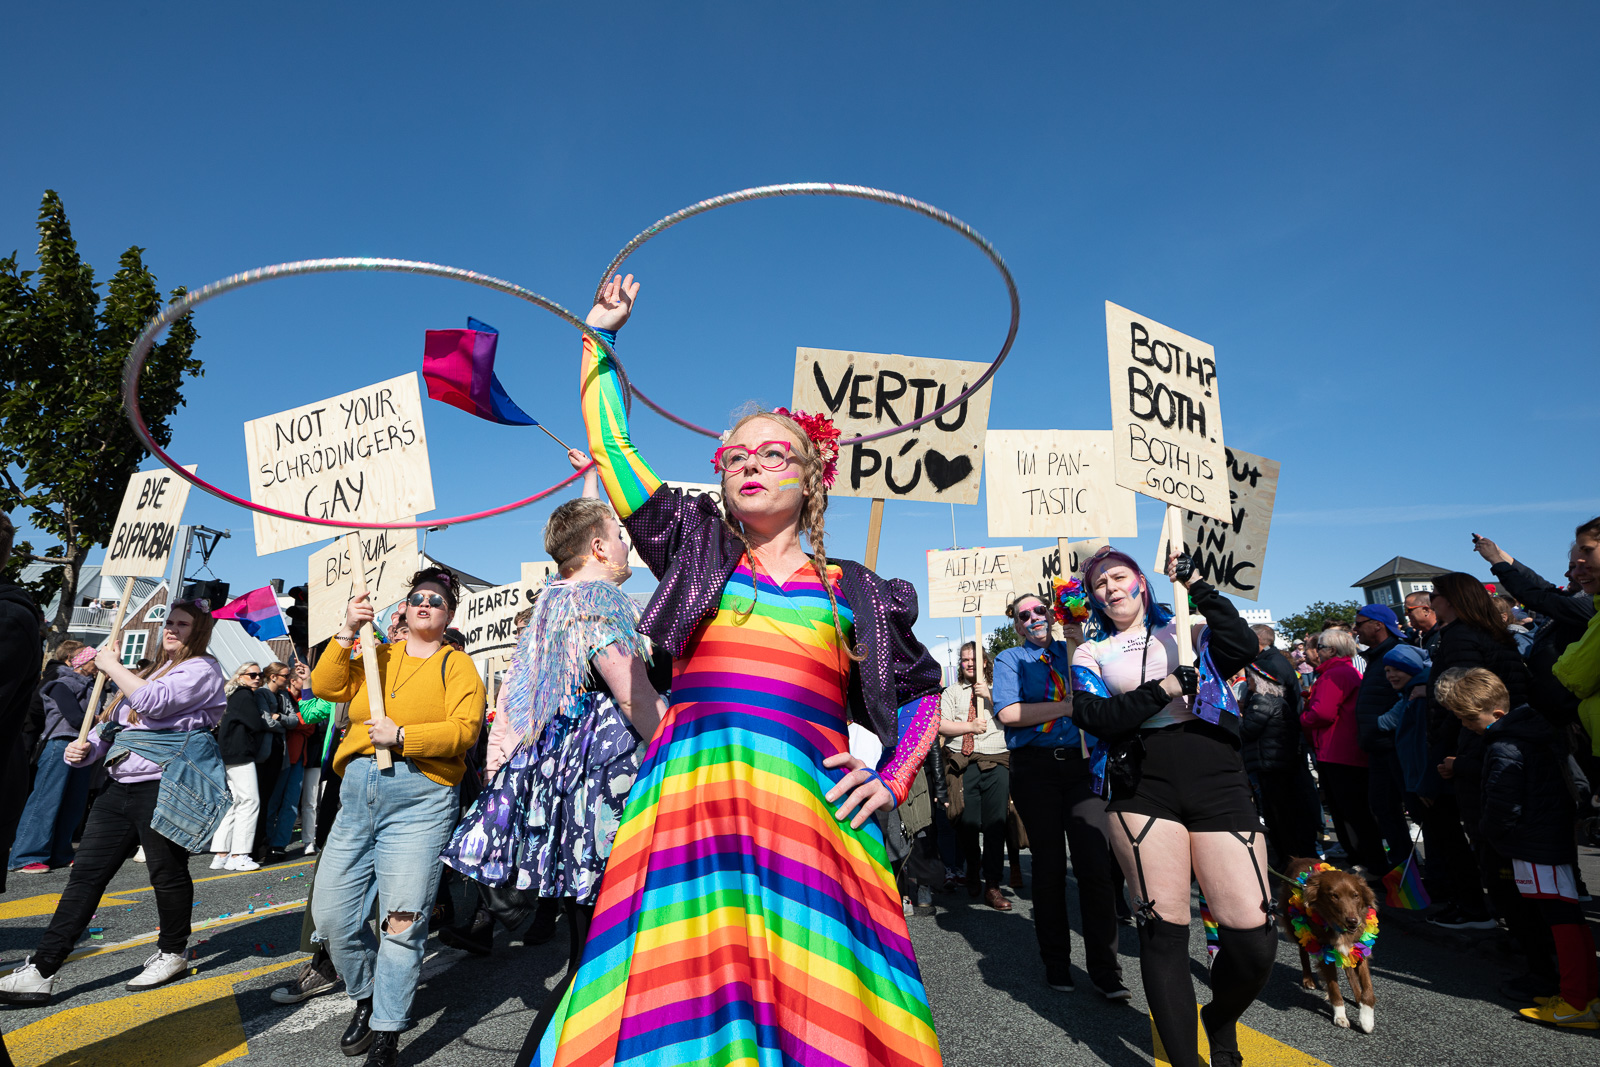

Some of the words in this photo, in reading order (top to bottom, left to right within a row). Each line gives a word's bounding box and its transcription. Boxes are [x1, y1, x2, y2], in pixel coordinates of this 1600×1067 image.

[1130, 321, 1217, 398] BOTH?
[813, 360, 969, 433] VERTU
[1128, 366, 1217, 444] BOTH.
[275, 407, 327, 452] NOT
[339, 388, 398, 430] YOUR
[1017, 449, 1037, 476] I'M
[1048, 451, 1090, 476] PAN-
[1128, 422, 1191, 476] BOTH
[1197, 454, 1214, 480] IS
[136, 476, 171, 511] BYE
[304, 471, 364, 520] GAY
[1022, 487, 1087, 516] TASTIC
[110, 521, 175, 562] BIPHOBIA
[1197, 525, 1226, 553] IN
[325, 528, 397, 587] BISXUAL
[944, 556, 970, 578] ALLT
[1042, 548, 1079, 579] NÓU
[972, 577, 998, 592] VERA
[467, 588, 519, 621] HEARTS
[962, 595, 982, 613] BI
[463, 626, 483, 647] NOT
